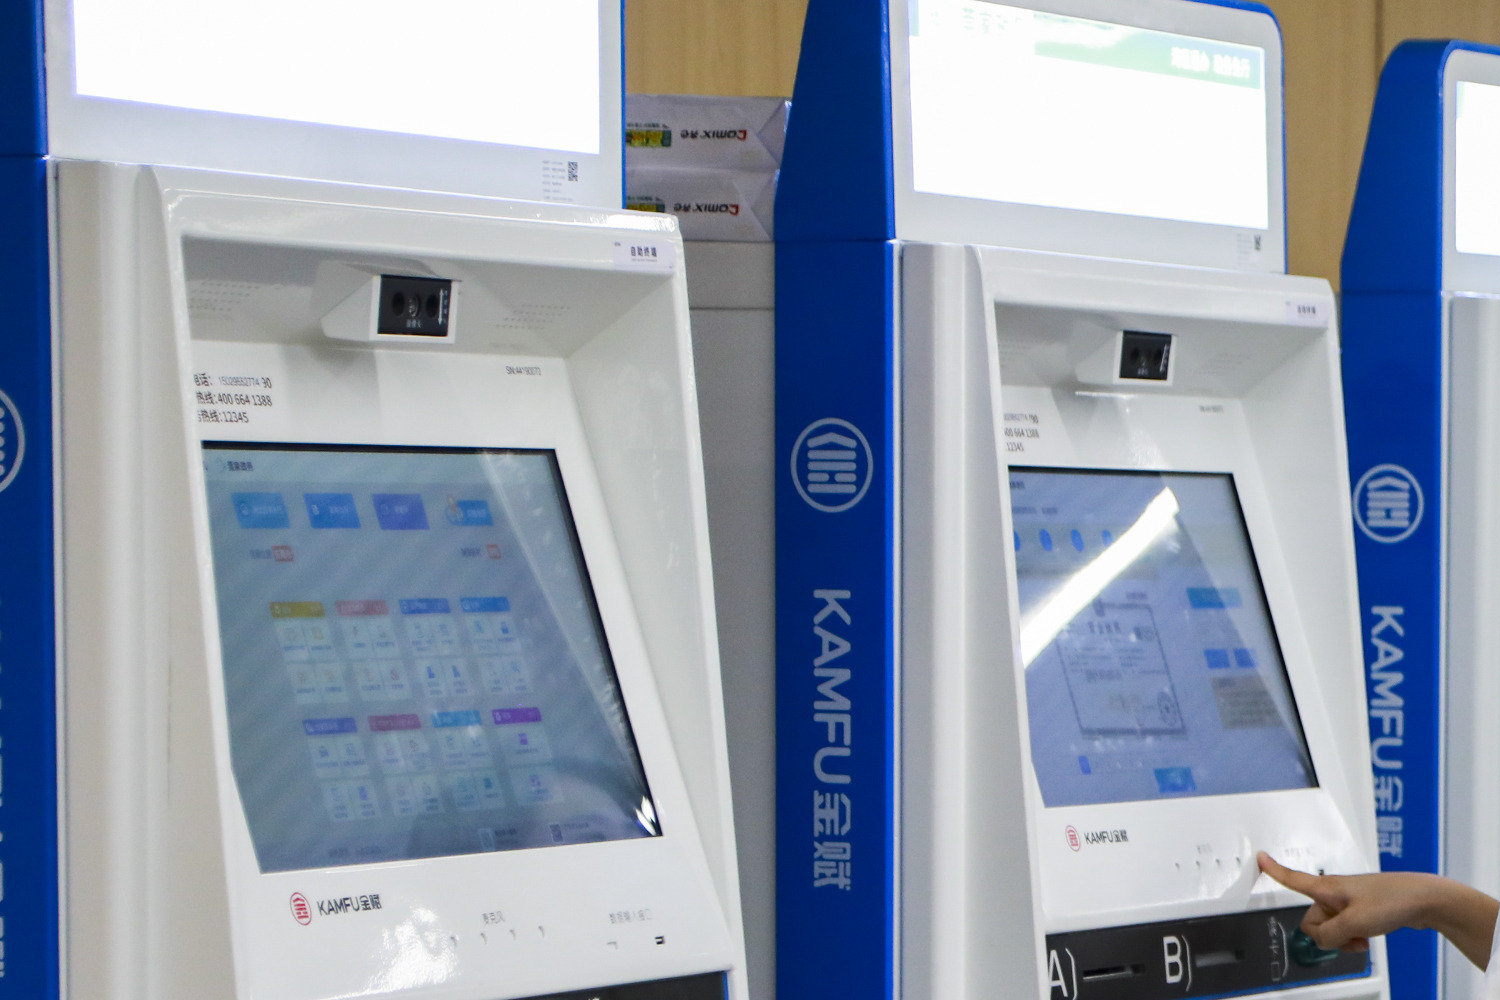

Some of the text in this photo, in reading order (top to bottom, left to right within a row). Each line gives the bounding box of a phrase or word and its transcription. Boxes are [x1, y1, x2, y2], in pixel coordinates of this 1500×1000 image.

[630, 246, 658, 258] 自助终端
[234, 393, 251, 406] 664
[251, 394, 273, 407] 1388
